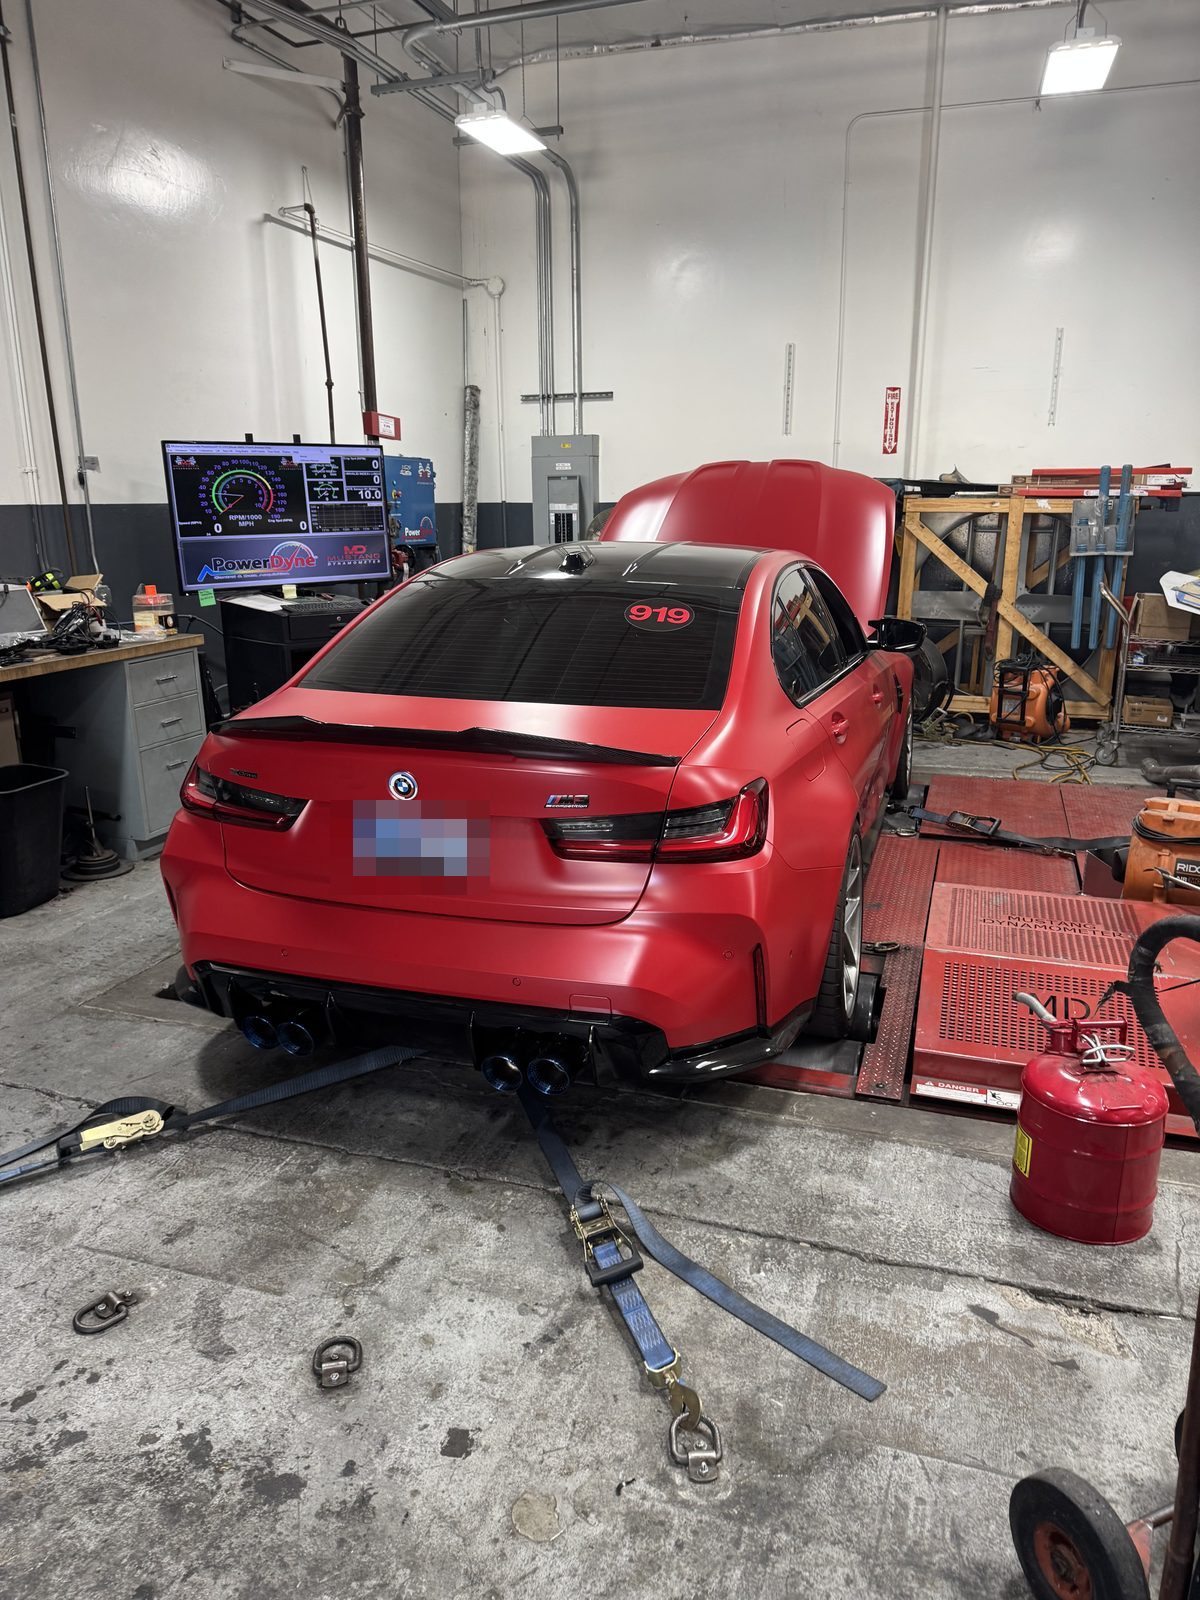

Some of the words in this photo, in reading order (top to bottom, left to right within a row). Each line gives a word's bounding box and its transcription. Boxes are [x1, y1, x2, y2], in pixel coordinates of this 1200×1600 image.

[372, 460, 379, 469] 0
[373, 475, 380, 484] 0
[358, 490, 381, 499] 10.0
[214, 523, 222, 533] 0
[300, 521, 307, 530] 0
[404, 527, 433, 537] Power
[344, 545, 366, 555] MD
[326, 553, 381, 561] MUSTANG
[212, 554, 317, 572] PowerDyne
[629, 605, 690, 624] 919
[1008, 915, 1096, 929] MUSTANG
[983, 918, 1124, 938] DYNAMOMETER
[1029, 993, 1090, 1019] MD
[938, 1082, 979, 1093] DANGER
